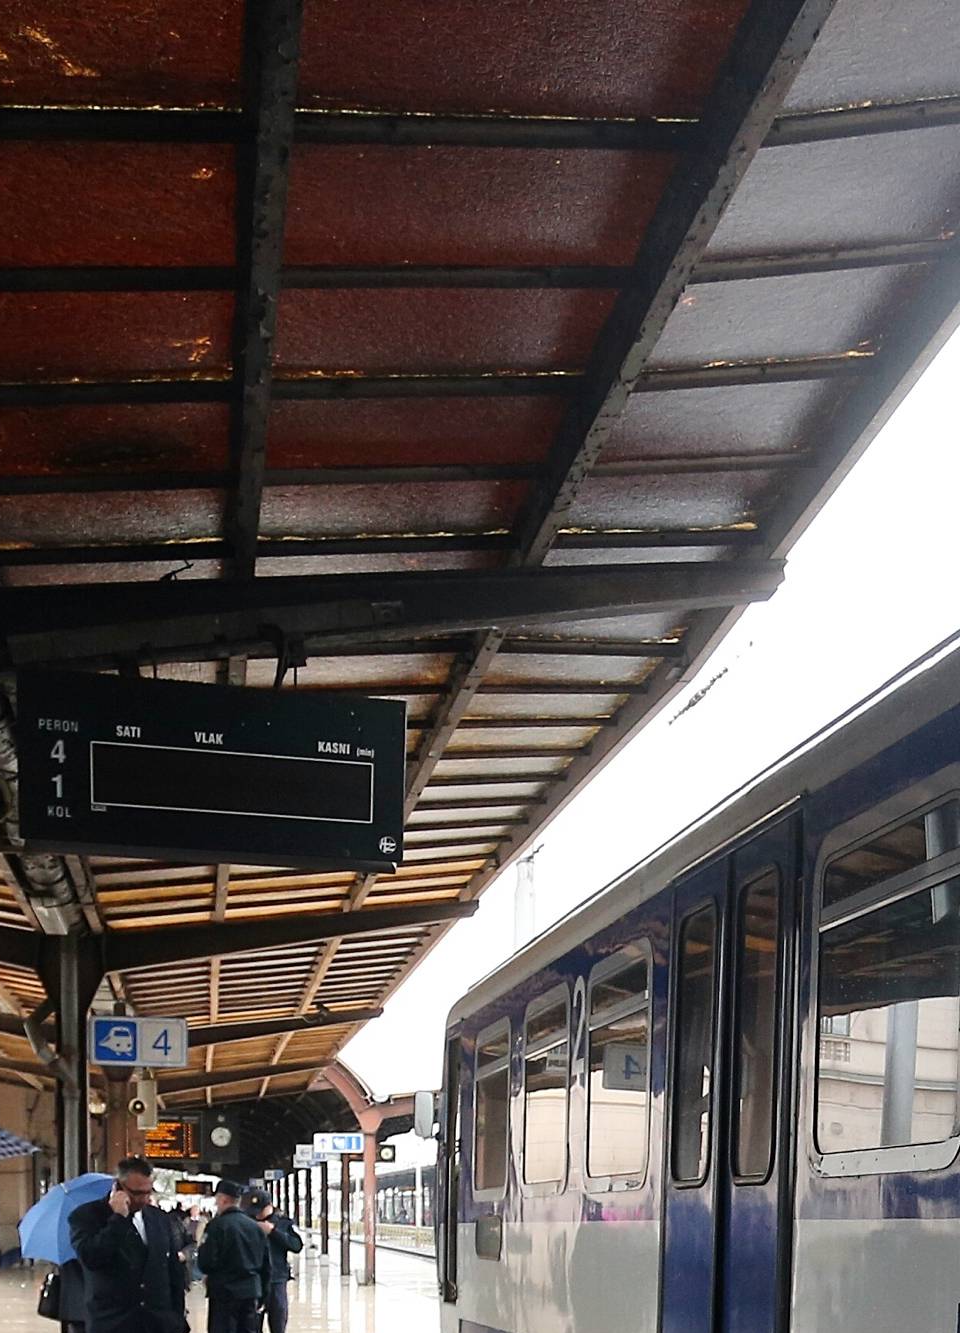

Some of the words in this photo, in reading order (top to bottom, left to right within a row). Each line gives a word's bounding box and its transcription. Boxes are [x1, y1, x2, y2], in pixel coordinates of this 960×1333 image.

[38, 718, 80, 733] PERON
[50, 739, 67, 764] 4
[115, 725, 142, 739] SATI
[194, 731, 225, 746] VLAK
[317, 741, 351, 756] KASNI
[50, 774, 63, 799] 1
[47, 805, 73, 819] KOL
[151, 1028, 172, 1057] 4
